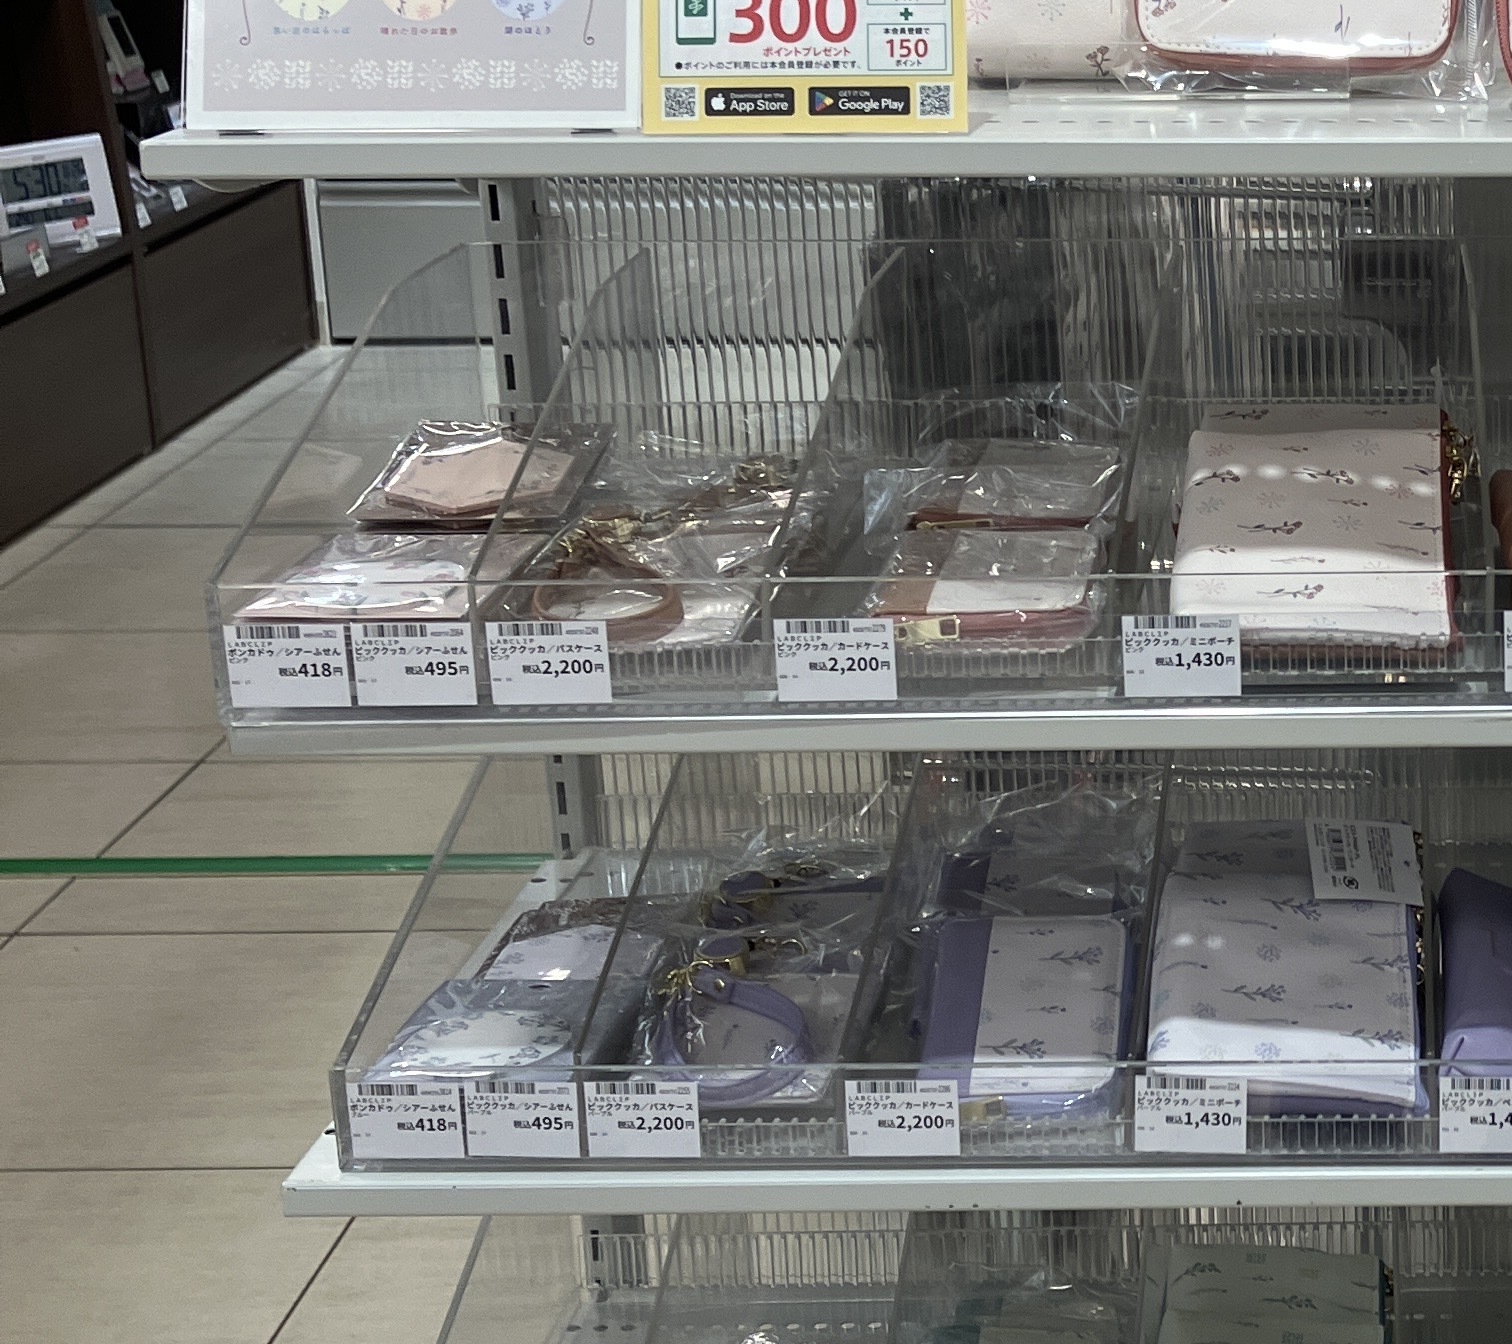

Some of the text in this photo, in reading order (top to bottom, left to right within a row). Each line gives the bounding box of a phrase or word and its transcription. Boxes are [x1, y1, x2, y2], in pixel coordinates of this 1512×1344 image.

[883, 27, 930, 36] 本会員登録で
[762, 46, 851, 58] ポイントプレゼント
[885, 38, 929, 59] 150
[894, 59, 922, 67] ポイント
[730, 100, 789, 113] App Store
[838, 99, 905, 113] Google Play
[405, 661, 469, 676] 税込495円
[809, 657, 890, 675] 税込2,200円
[1156, 652, 1235, 670] 税込1,430円
[279, 662, 343, 677] 税込418円
[522, 660, 604, 678] 税込2,200円
[397, 1118, 457, 1131] 税込418円
[514, 1117, 574, 1130] 税込495円
[618, 1117, 694, 1133] 税込2,200円
[878, 1116, 954, 1132] 税込2,200円
[1166, 1112, 1241, 1129] 税込1,430円
